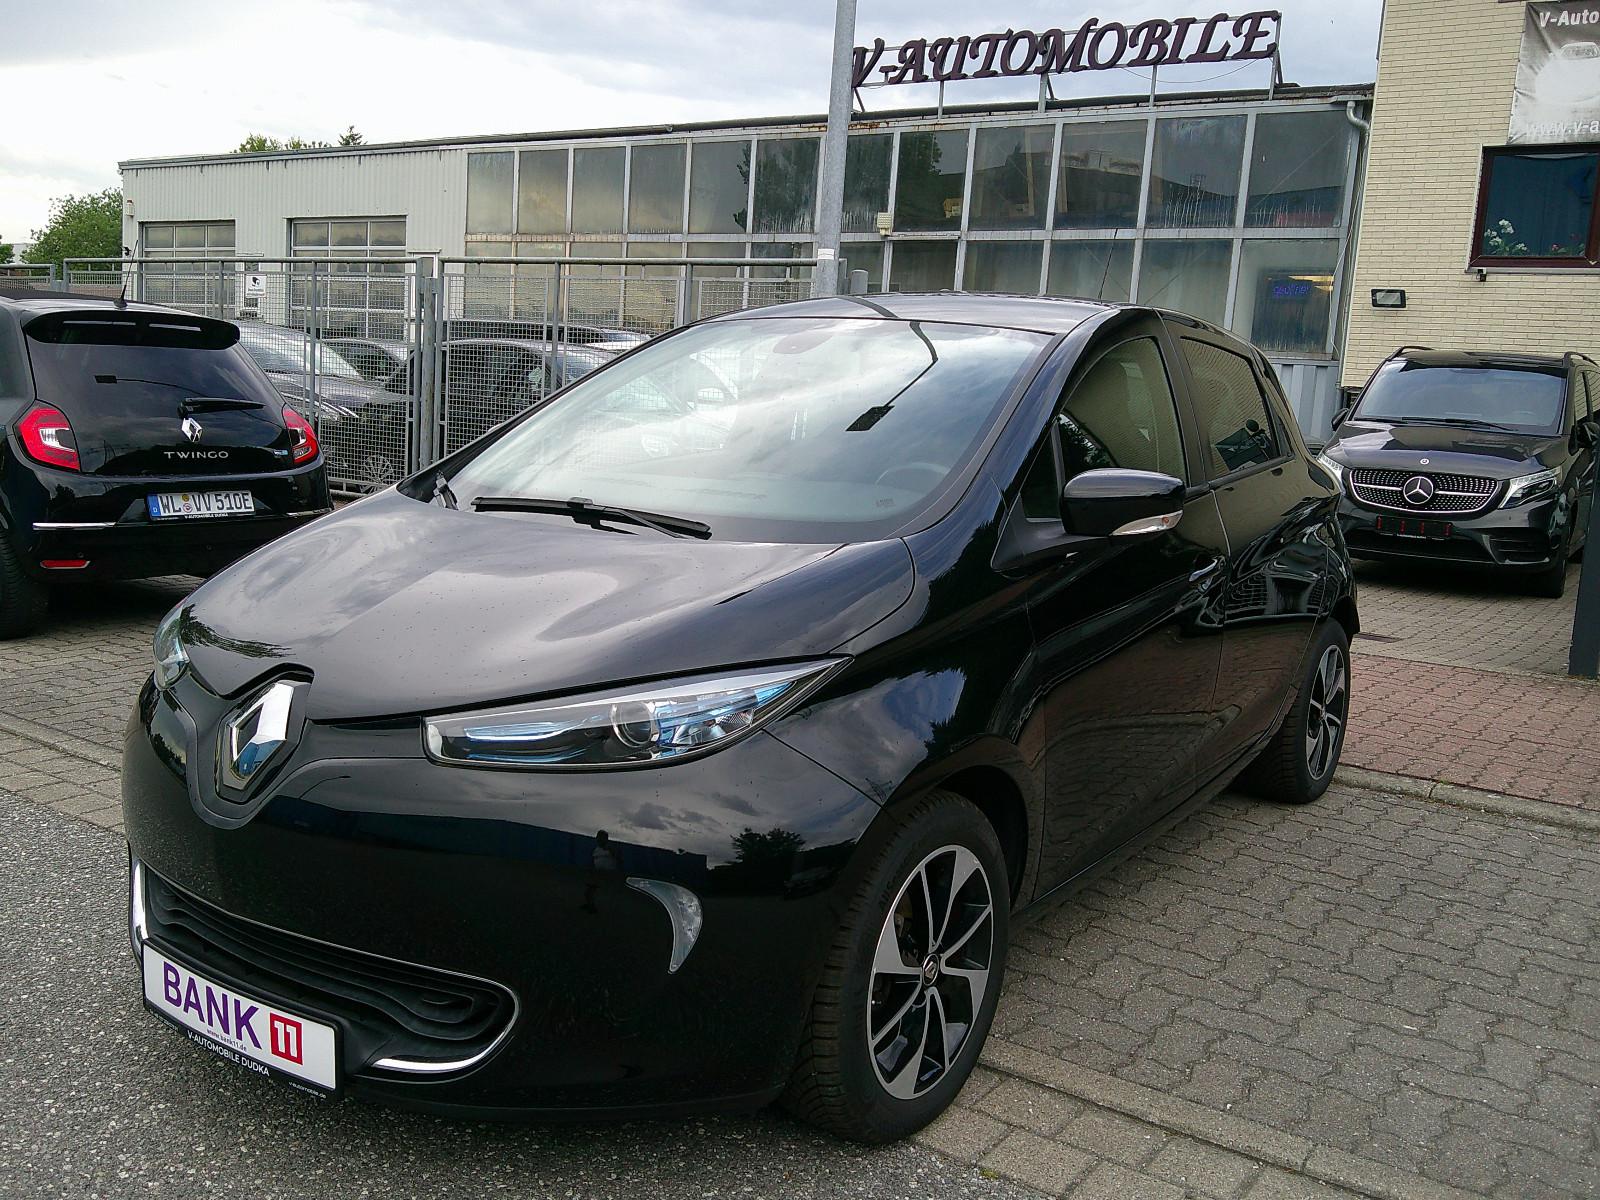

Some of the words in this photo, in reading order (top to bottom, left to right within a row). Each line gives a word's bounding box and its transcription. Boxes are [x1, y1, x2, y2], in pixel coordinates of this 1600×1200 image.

[852, 11, 1281, 88] V-AUTOMOBILE
[163, 450, 229, 459] TWINGO
[160, 495, 182, 513] WL
[163, 961, 262, 1050] BANK
[273, 1017, 299, 1060] 11
[187, 1029, 240, 1064] V-AUTOMOBILE
[241, 1057, 270, 1077] DUDKA
